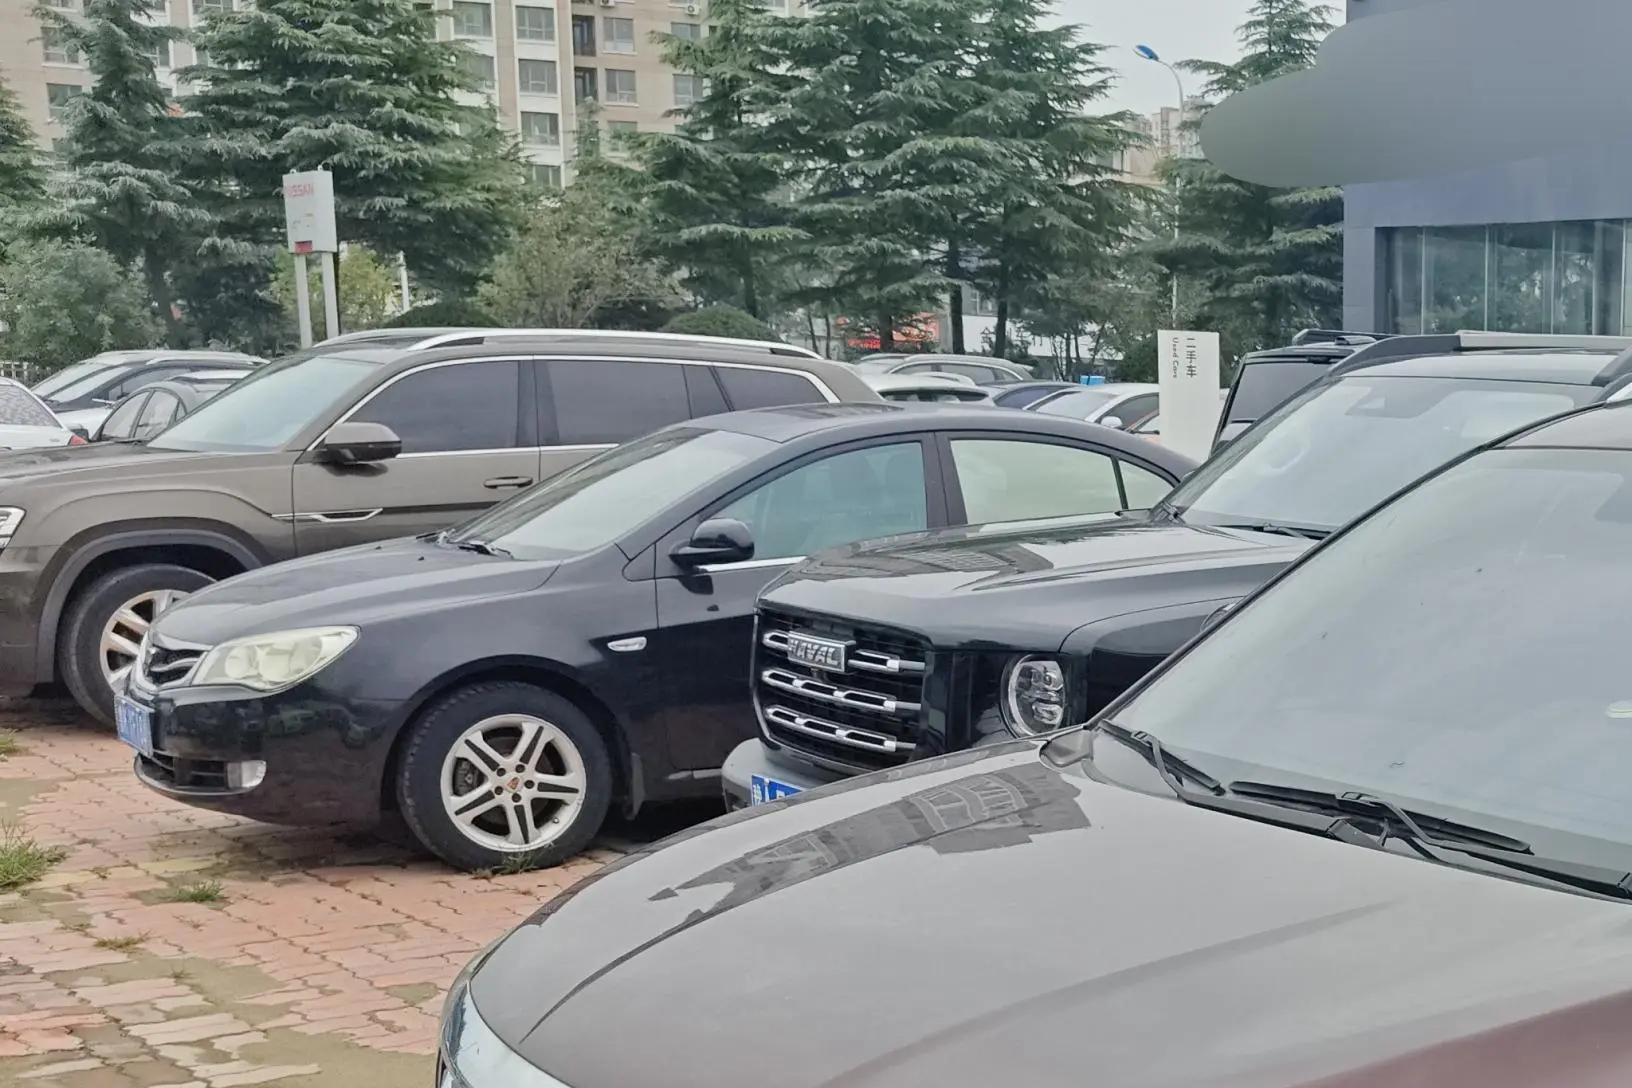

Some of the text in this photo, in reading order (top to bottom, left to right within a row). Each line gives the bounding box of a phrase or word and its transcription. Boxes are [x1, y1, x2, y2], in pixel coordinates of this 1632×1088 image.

[1185, 337, 1197, 378] 二手车
[788, 637, 840, 667] HAVAL
